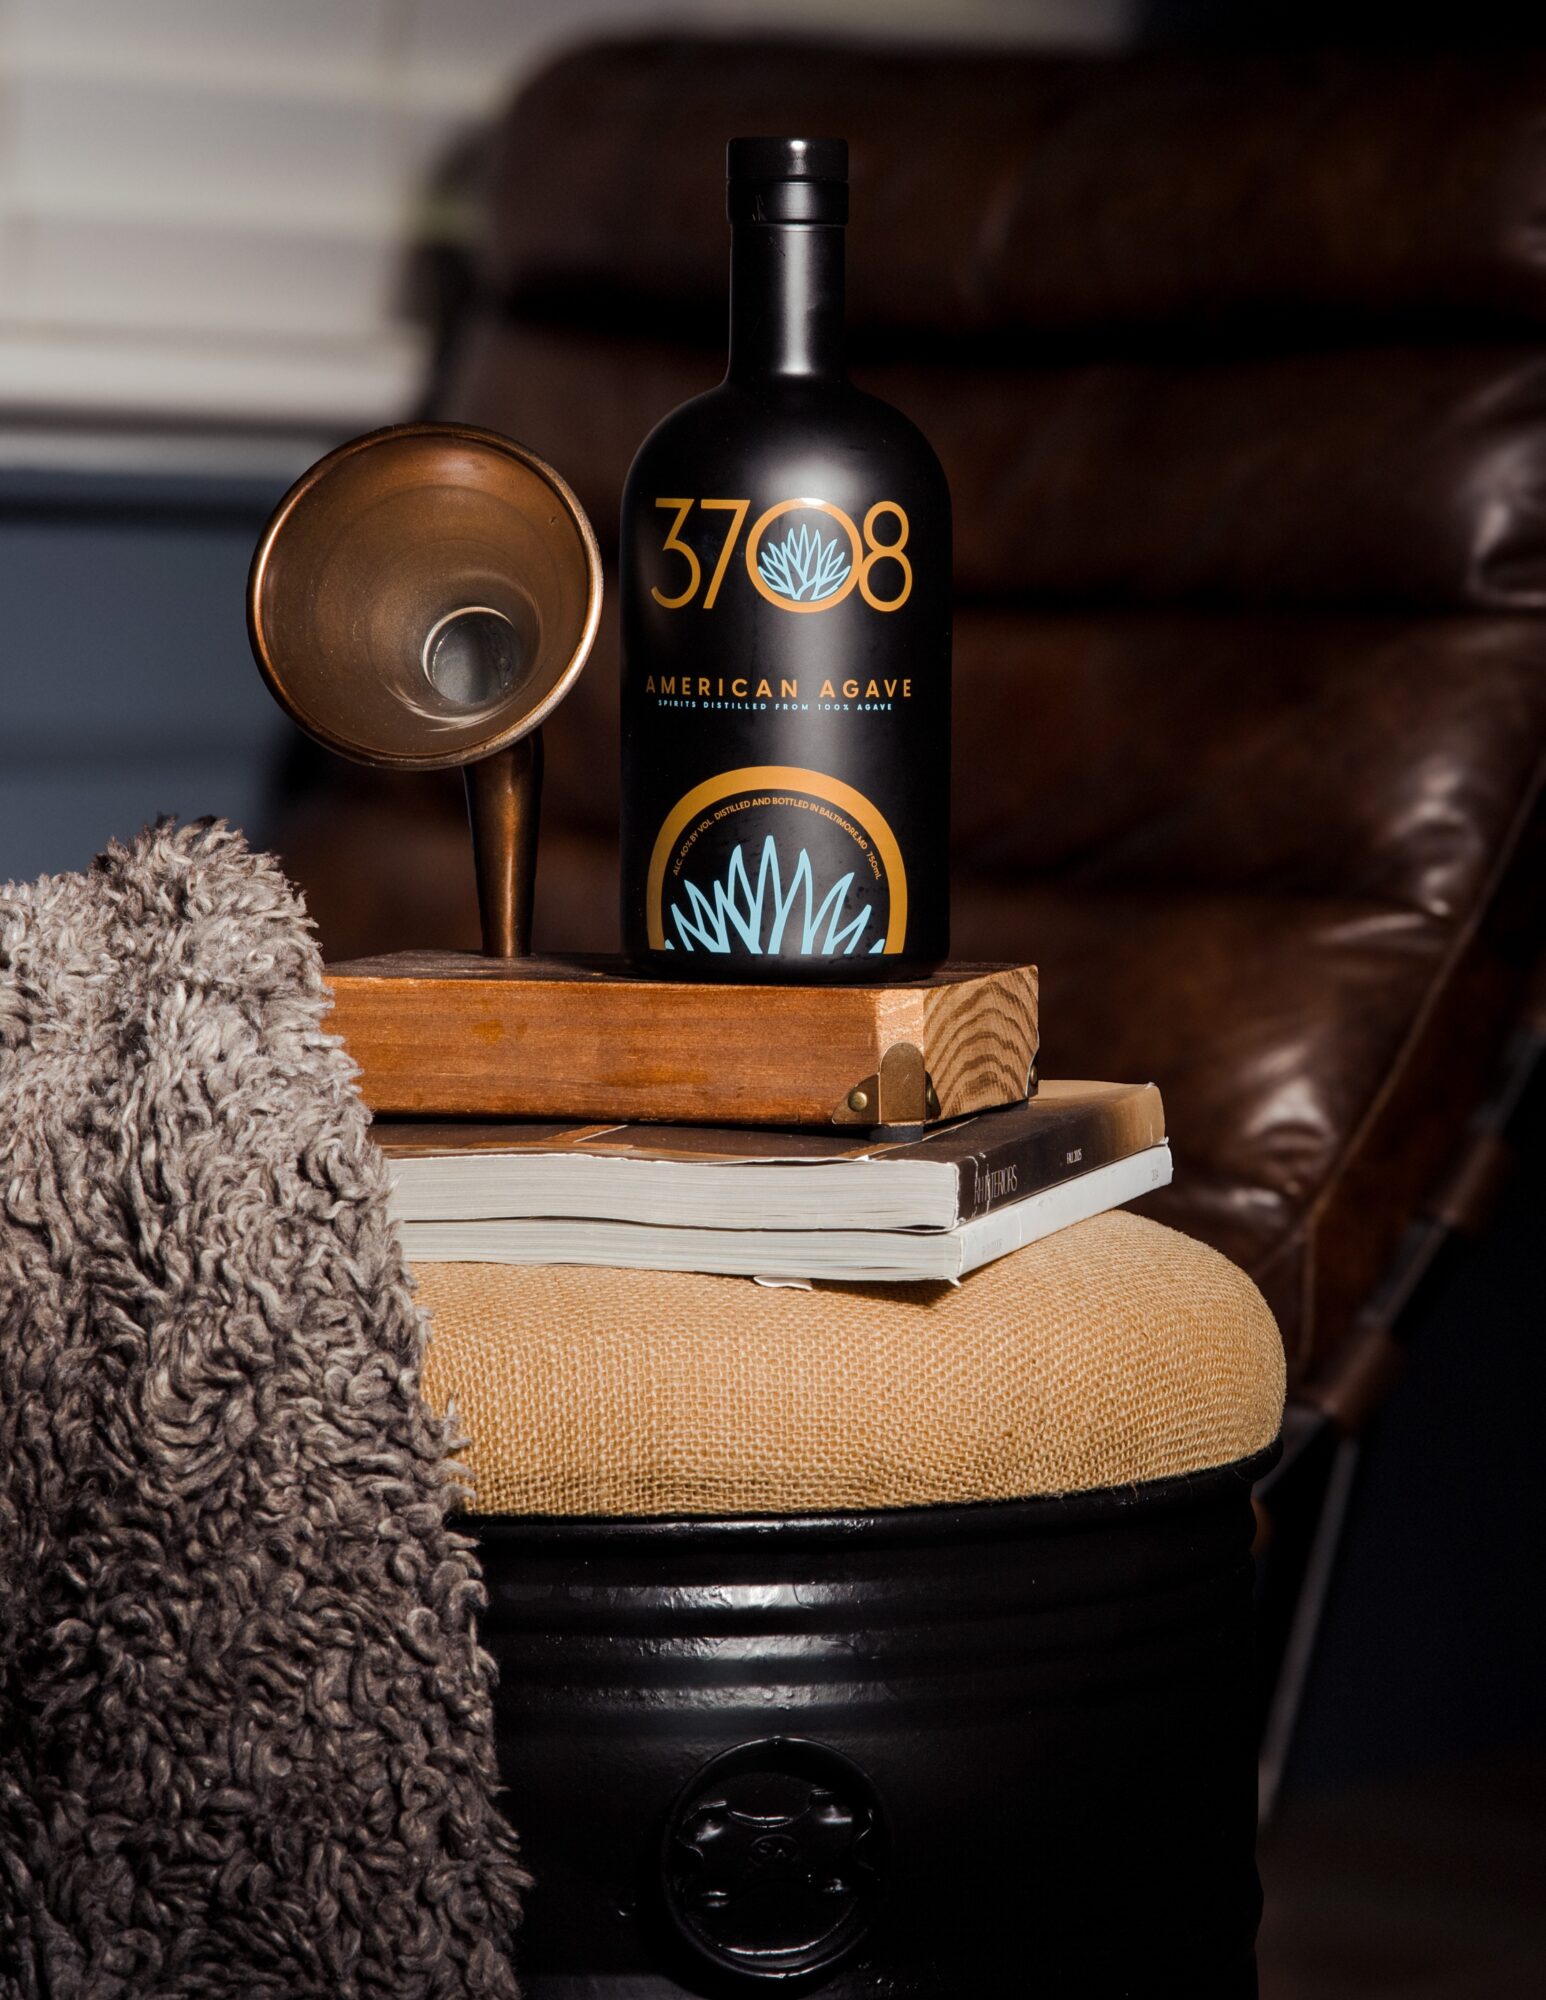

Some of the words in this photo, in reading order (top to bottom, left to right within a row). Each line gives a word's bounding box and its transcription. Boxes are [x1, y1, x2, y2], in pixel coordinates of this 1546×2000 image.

[650, 498, 913, 613] 3708
[646, 675, 798, 698] AMERICAN
[819, 679, 912, 698] AGAVE
[658, 699, 697, 708] SPIRITS
[703, 701, 767, 710] DISTILLED
[775, 703, 809, 711] FROM
[818, 703, 849, 711] 100%
[857, 703, 892, 711] AGAVE
[689, 830, 699, 843] BY
[714, 800, 751, 820] DISTILLED
[752, 797, 771, 807] AND
[772, 797, 809, 809] BOTTLED
[809, 803, 819, 813] IN
